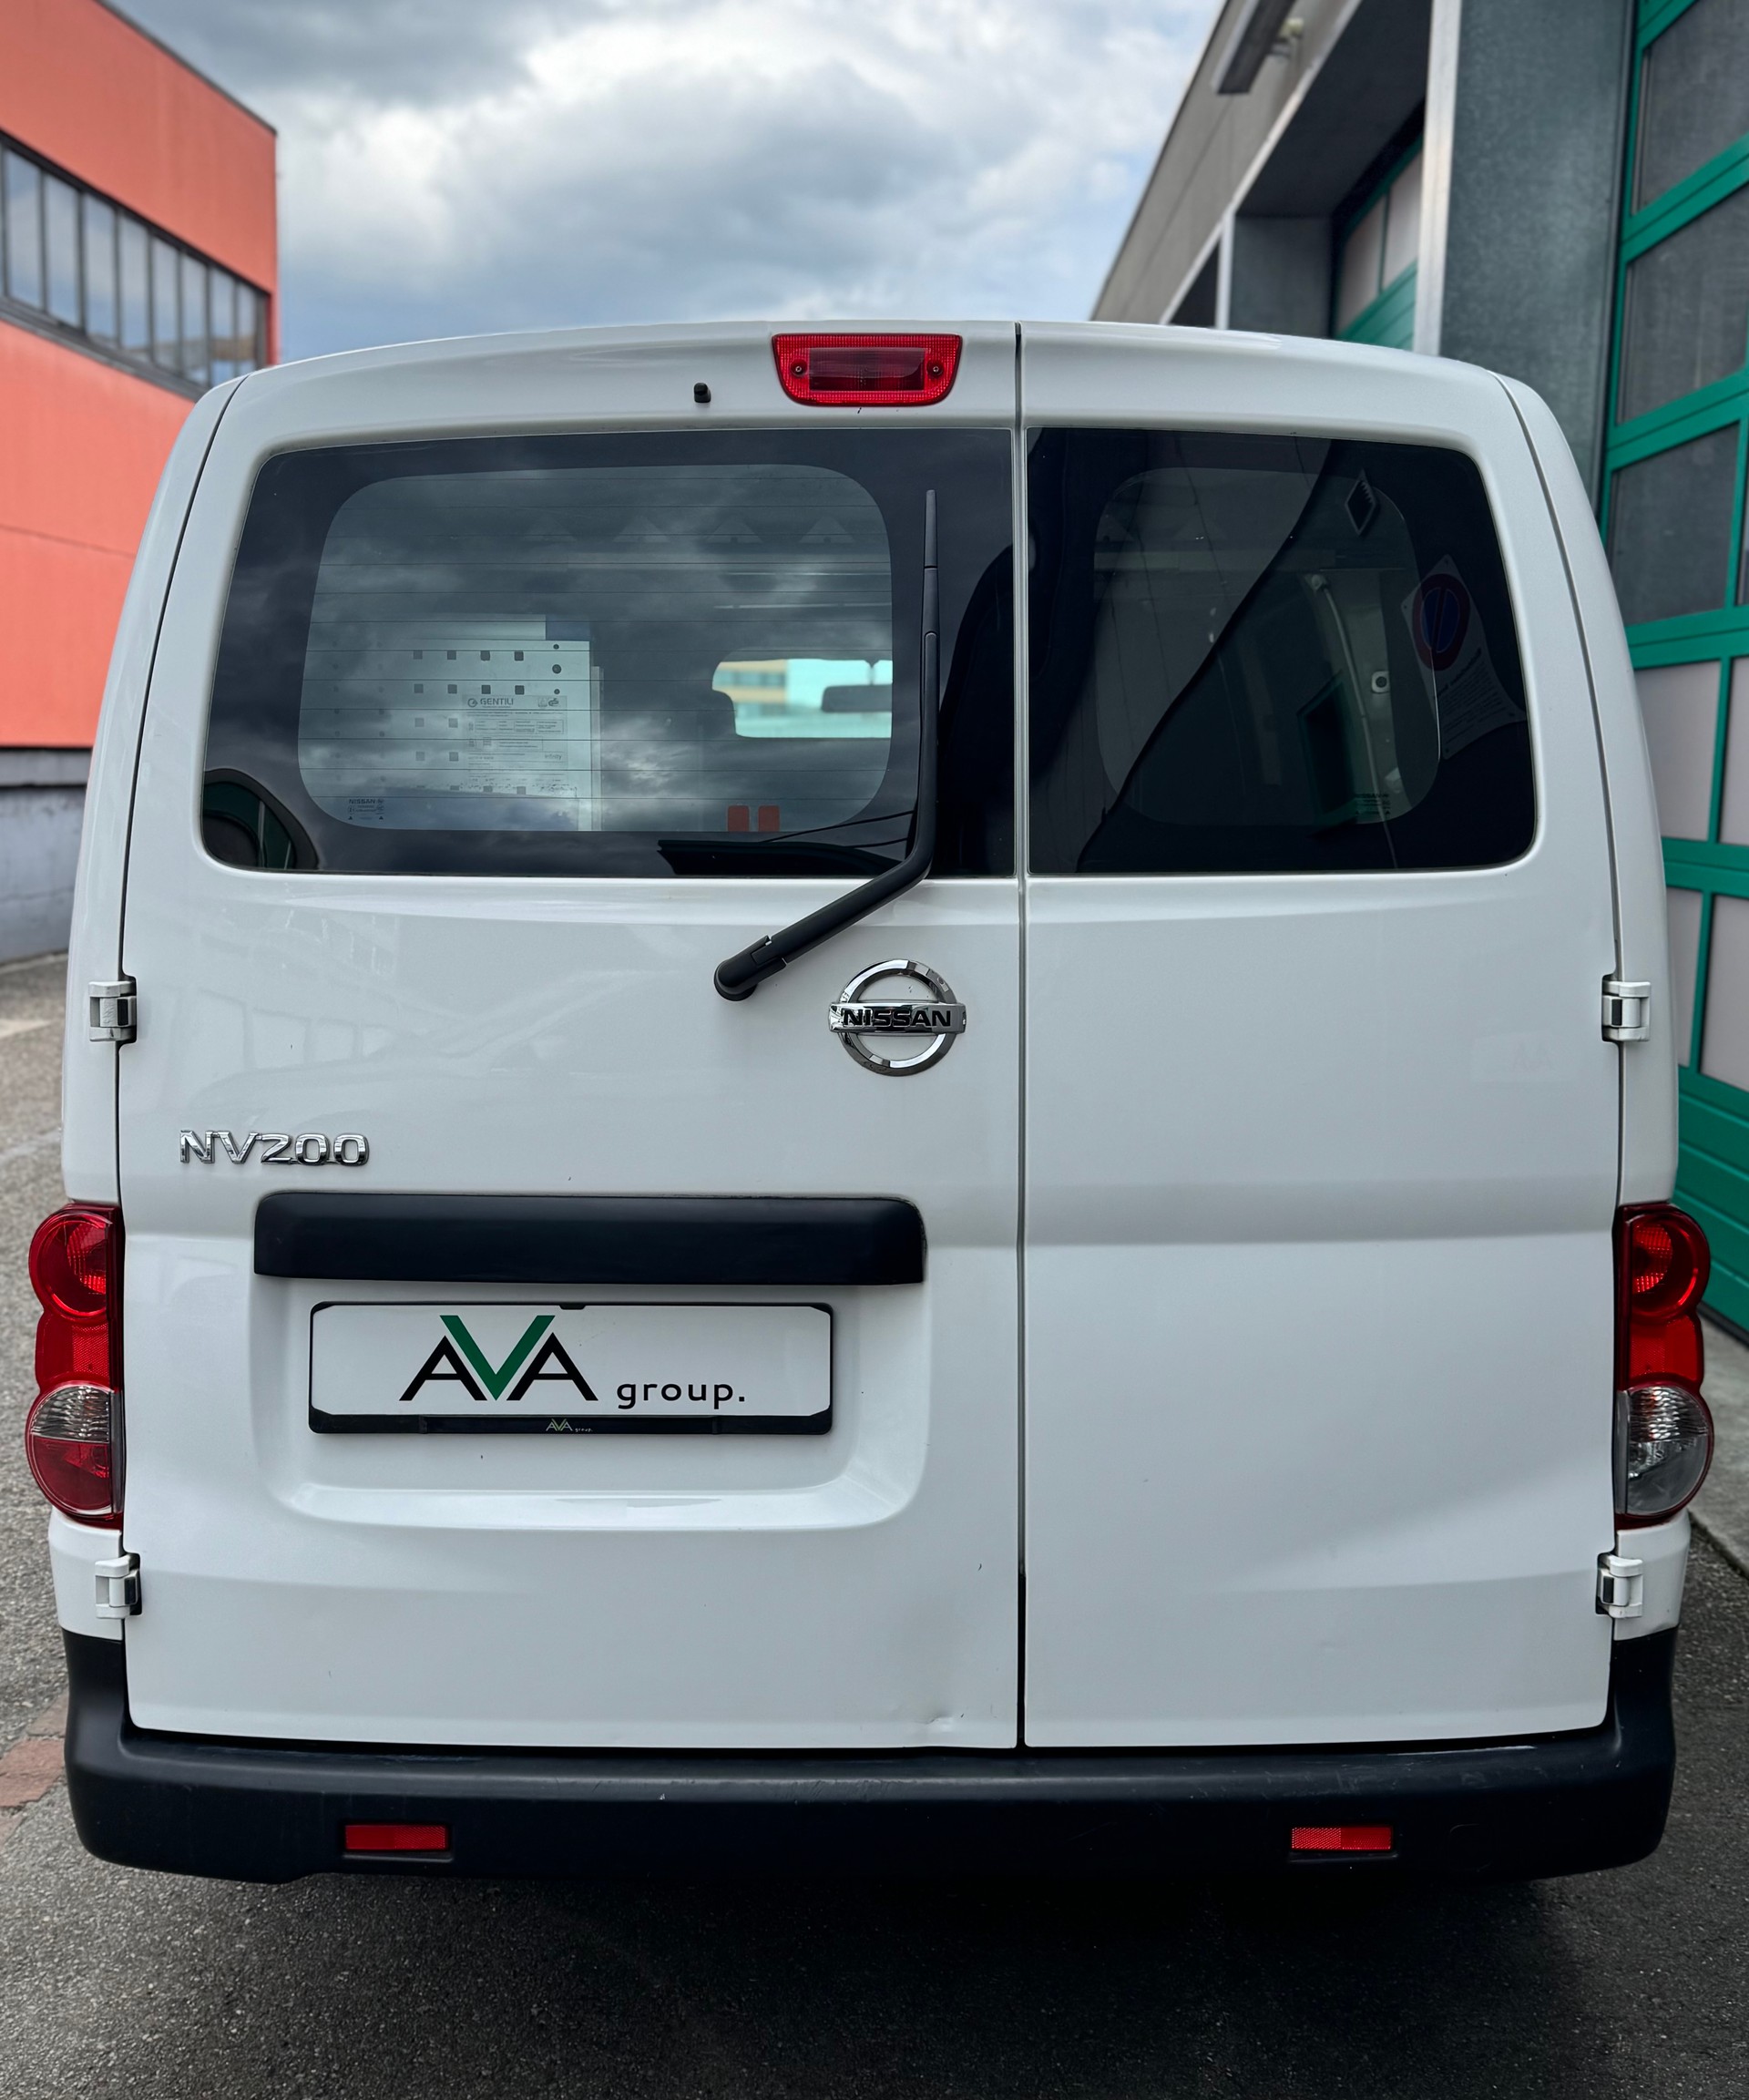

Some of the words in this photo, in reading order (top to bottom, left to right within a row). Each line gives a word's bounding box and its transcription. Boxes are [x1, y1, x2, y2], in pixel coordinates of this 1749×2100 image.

[480, 698, 514, 706] GENTILI
[843, 1008, 952, 1028] NISSAN
[180, 1130, 370, 1166] NV200
[398, 1315, 598, 1401] AVA
[617, 1382, 746, 1409] group.
[546, 1418, 573, 1431] AVA
